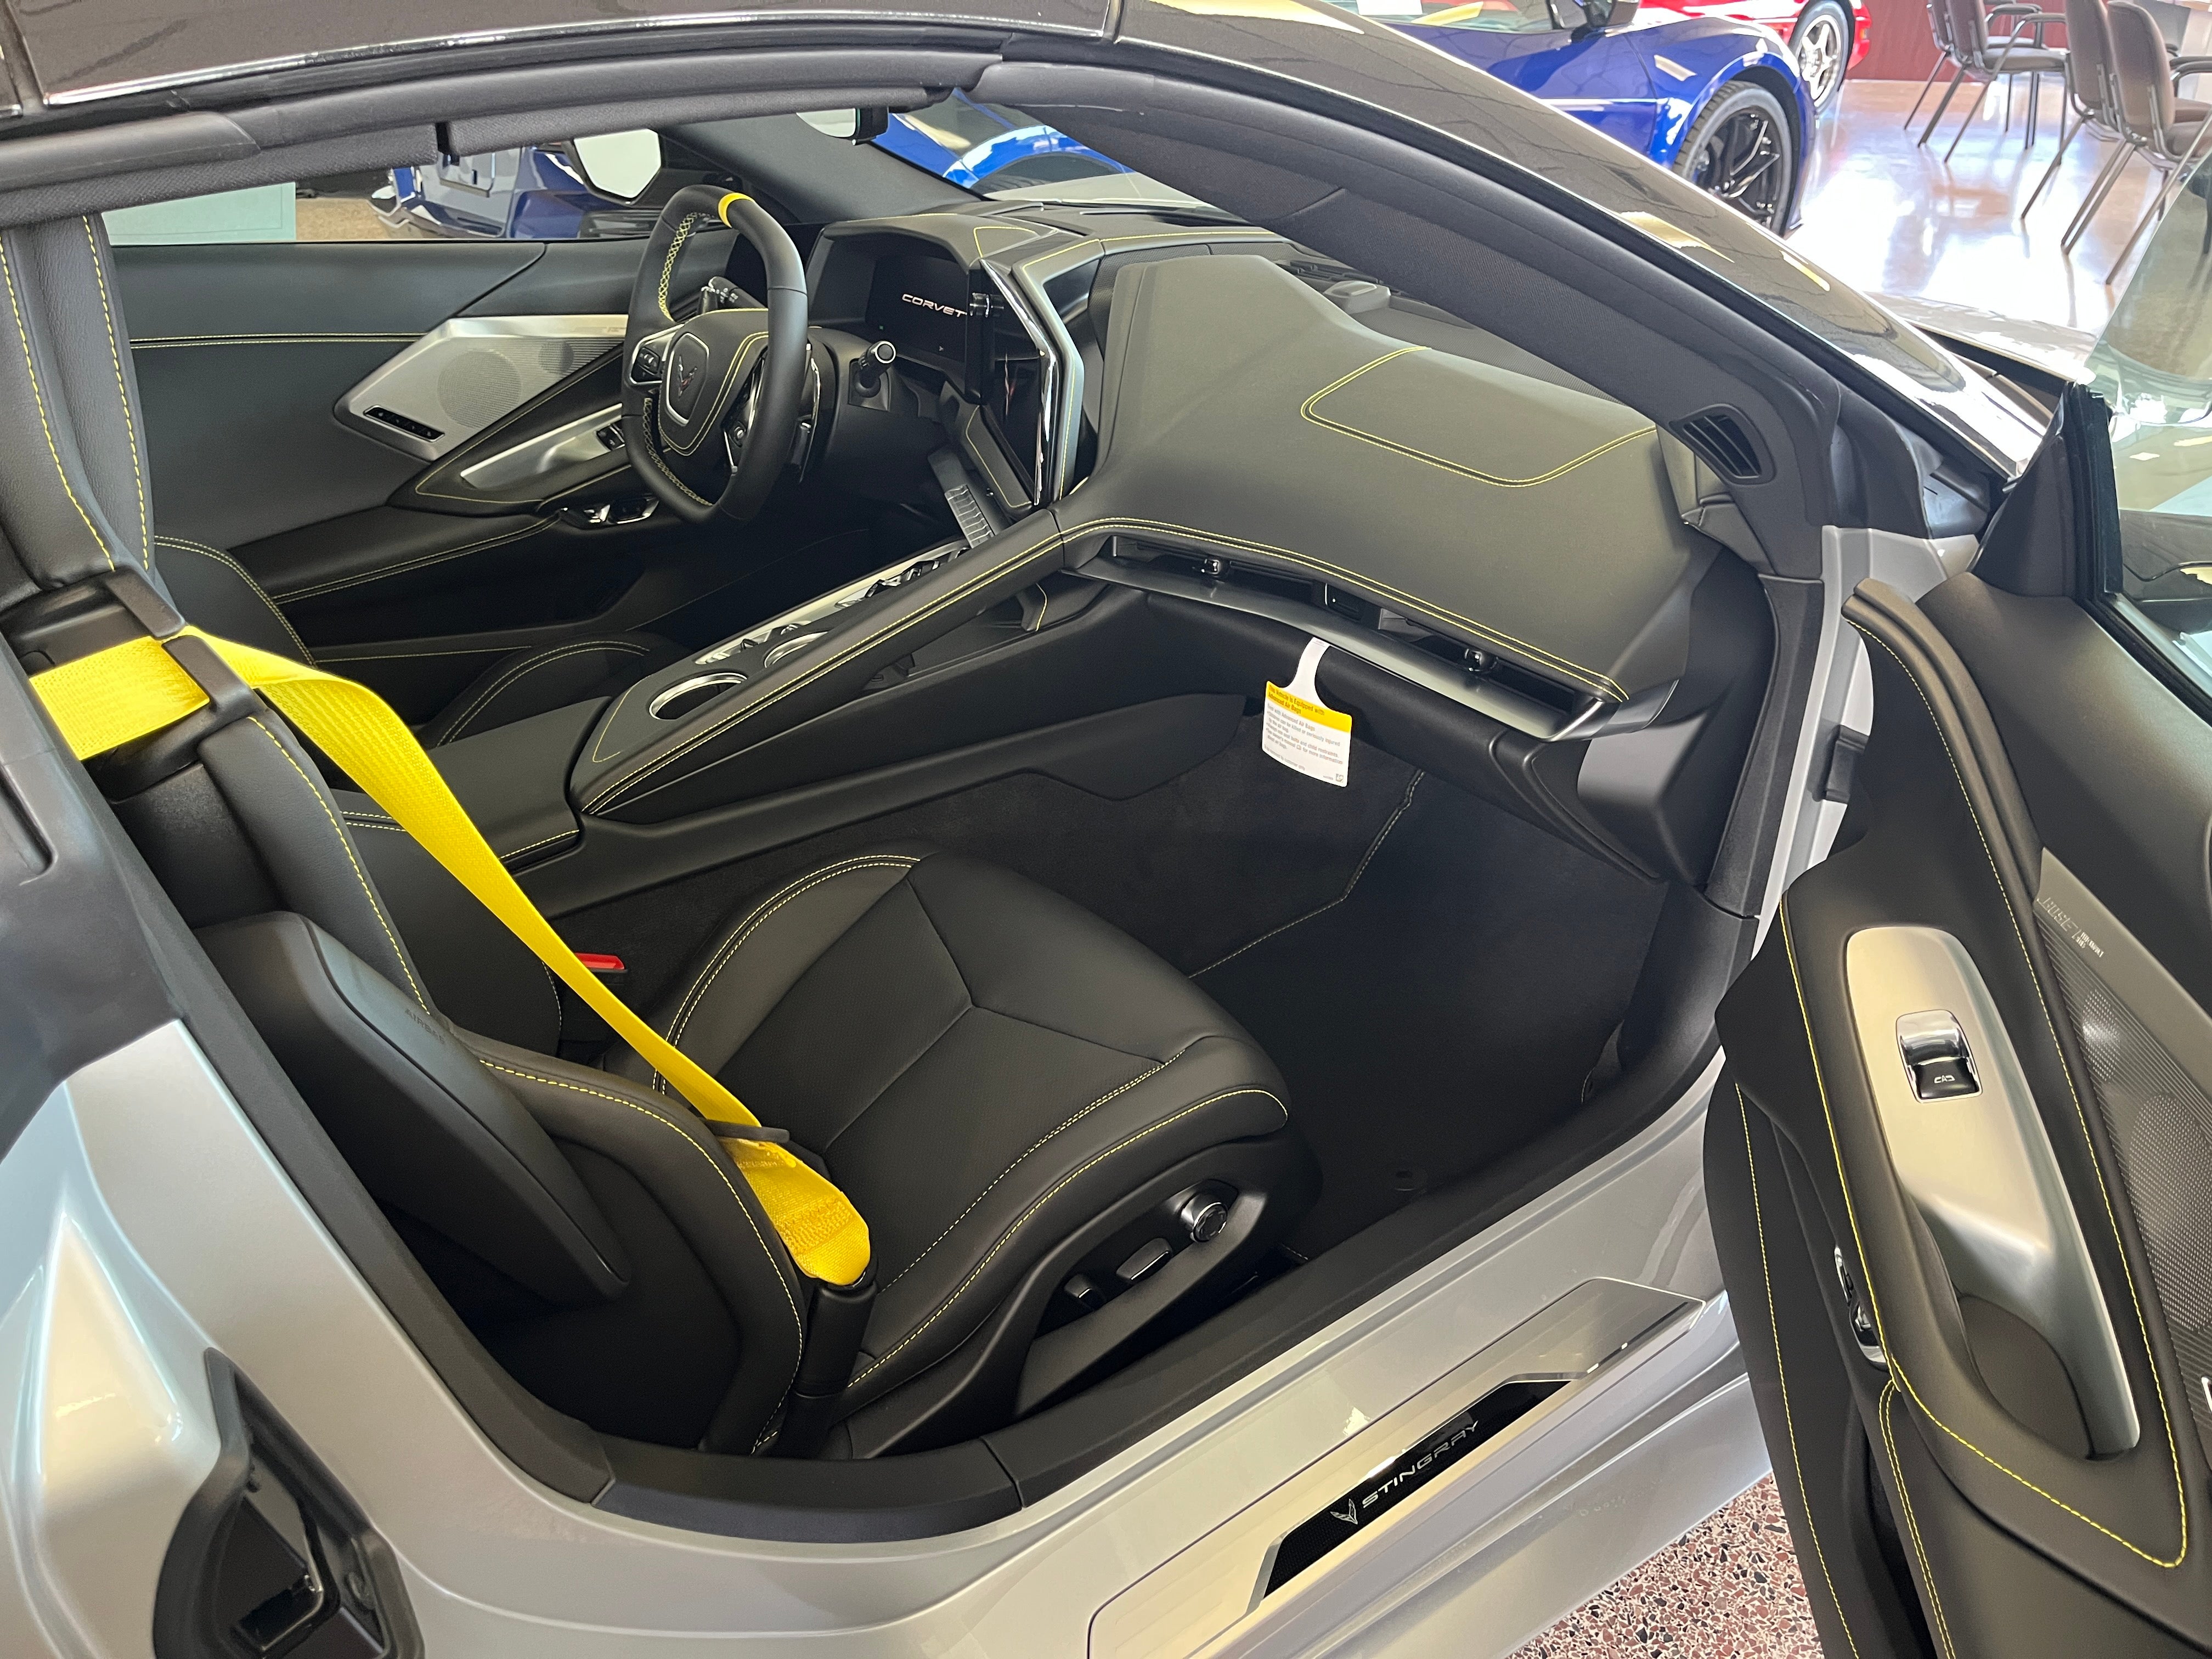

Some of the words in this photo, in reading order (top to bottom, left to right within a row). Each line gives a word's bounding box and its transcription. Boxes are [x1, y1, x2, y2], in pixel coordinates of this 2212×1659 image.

[902, 294, 967, 317] CORVET
[1294, 698, 1313, 712] Equipped
[1314, 707, 1325, 716] with
[2037, 897, 2078, 932] BOSE
[1362, 1420, 1479, 1509] STINGRAY
